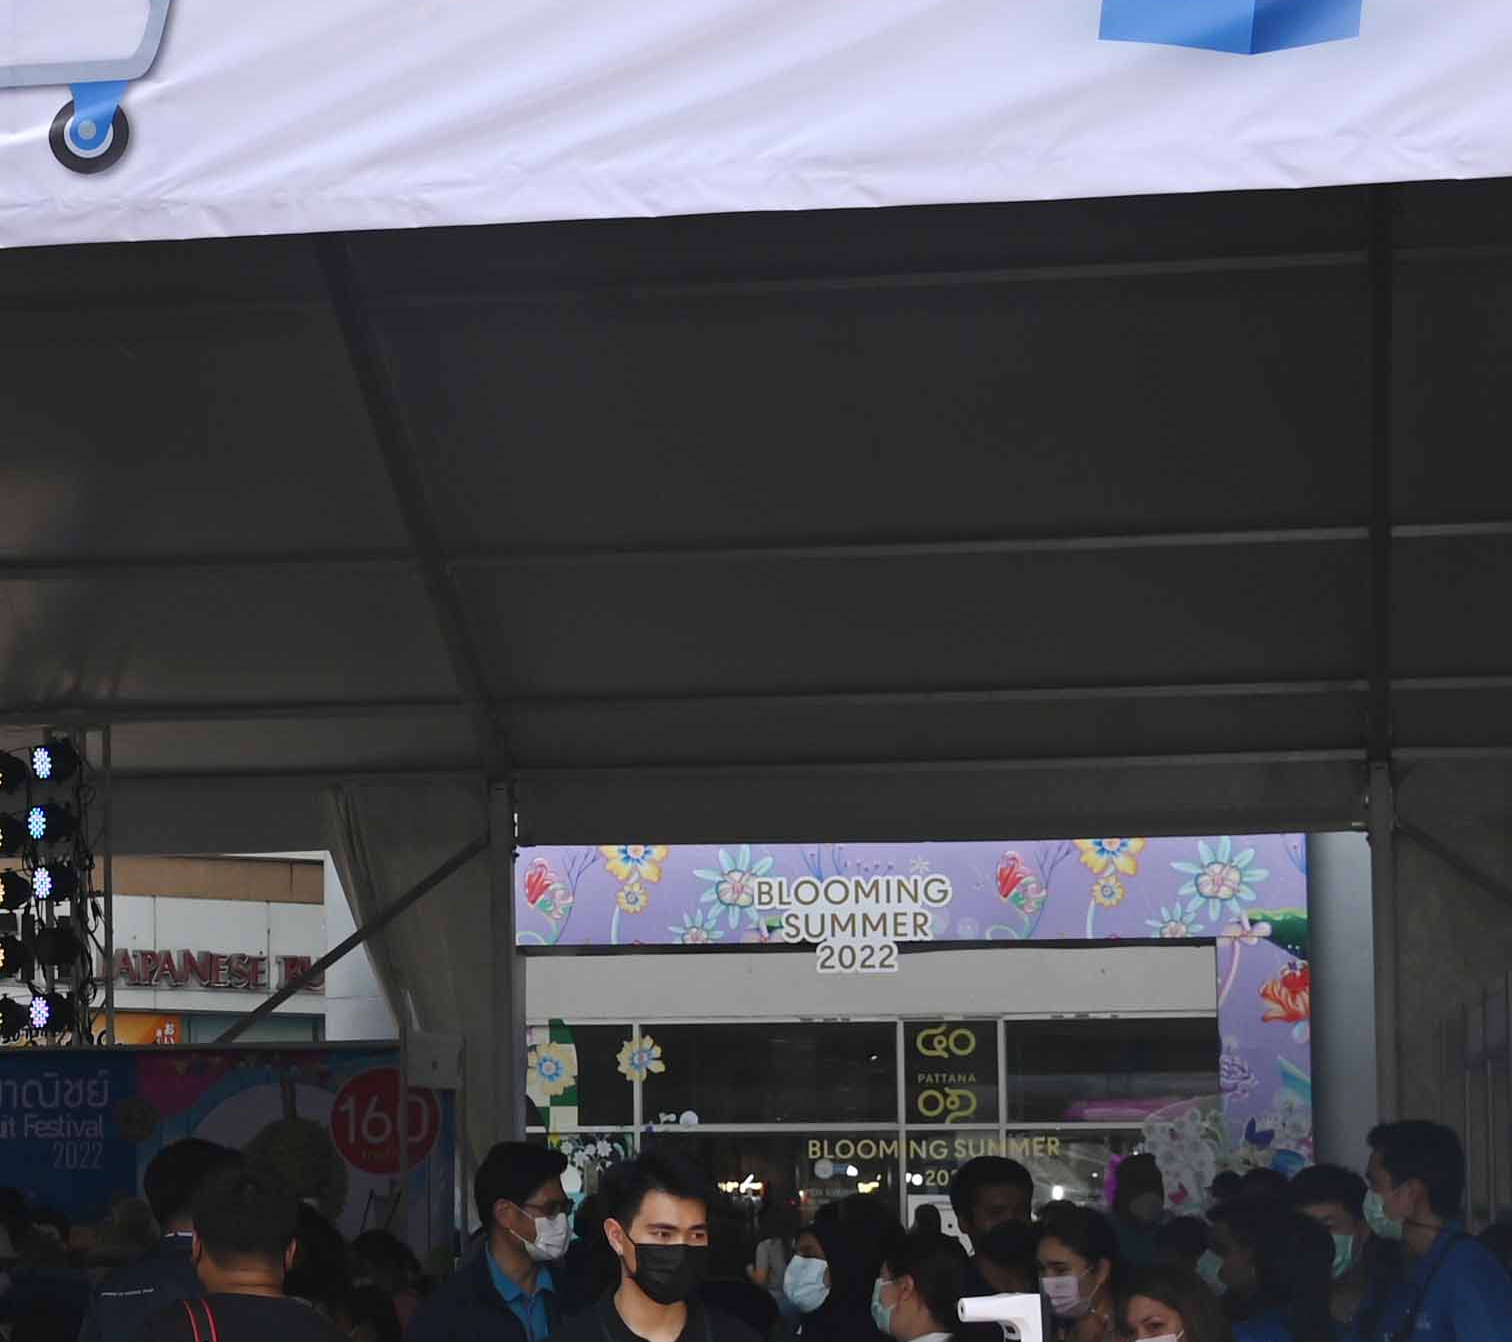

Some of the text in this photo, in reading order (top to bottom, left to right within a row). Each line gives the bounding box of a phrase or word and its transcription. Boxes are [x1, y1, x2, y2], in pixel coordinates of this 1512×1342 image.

[755, 878, 950, 907] BLOOMING
[783, 912, 930, 940] SUMMER
[819, 944, 896, 970] 2022
[917, 1073, 977, 1084] PATTANA
[22, 1114, 104, 1140] Festival
[52, 1141, 104, 1170] 2022
[807, 1138, 949, 1159] BLOOMING
